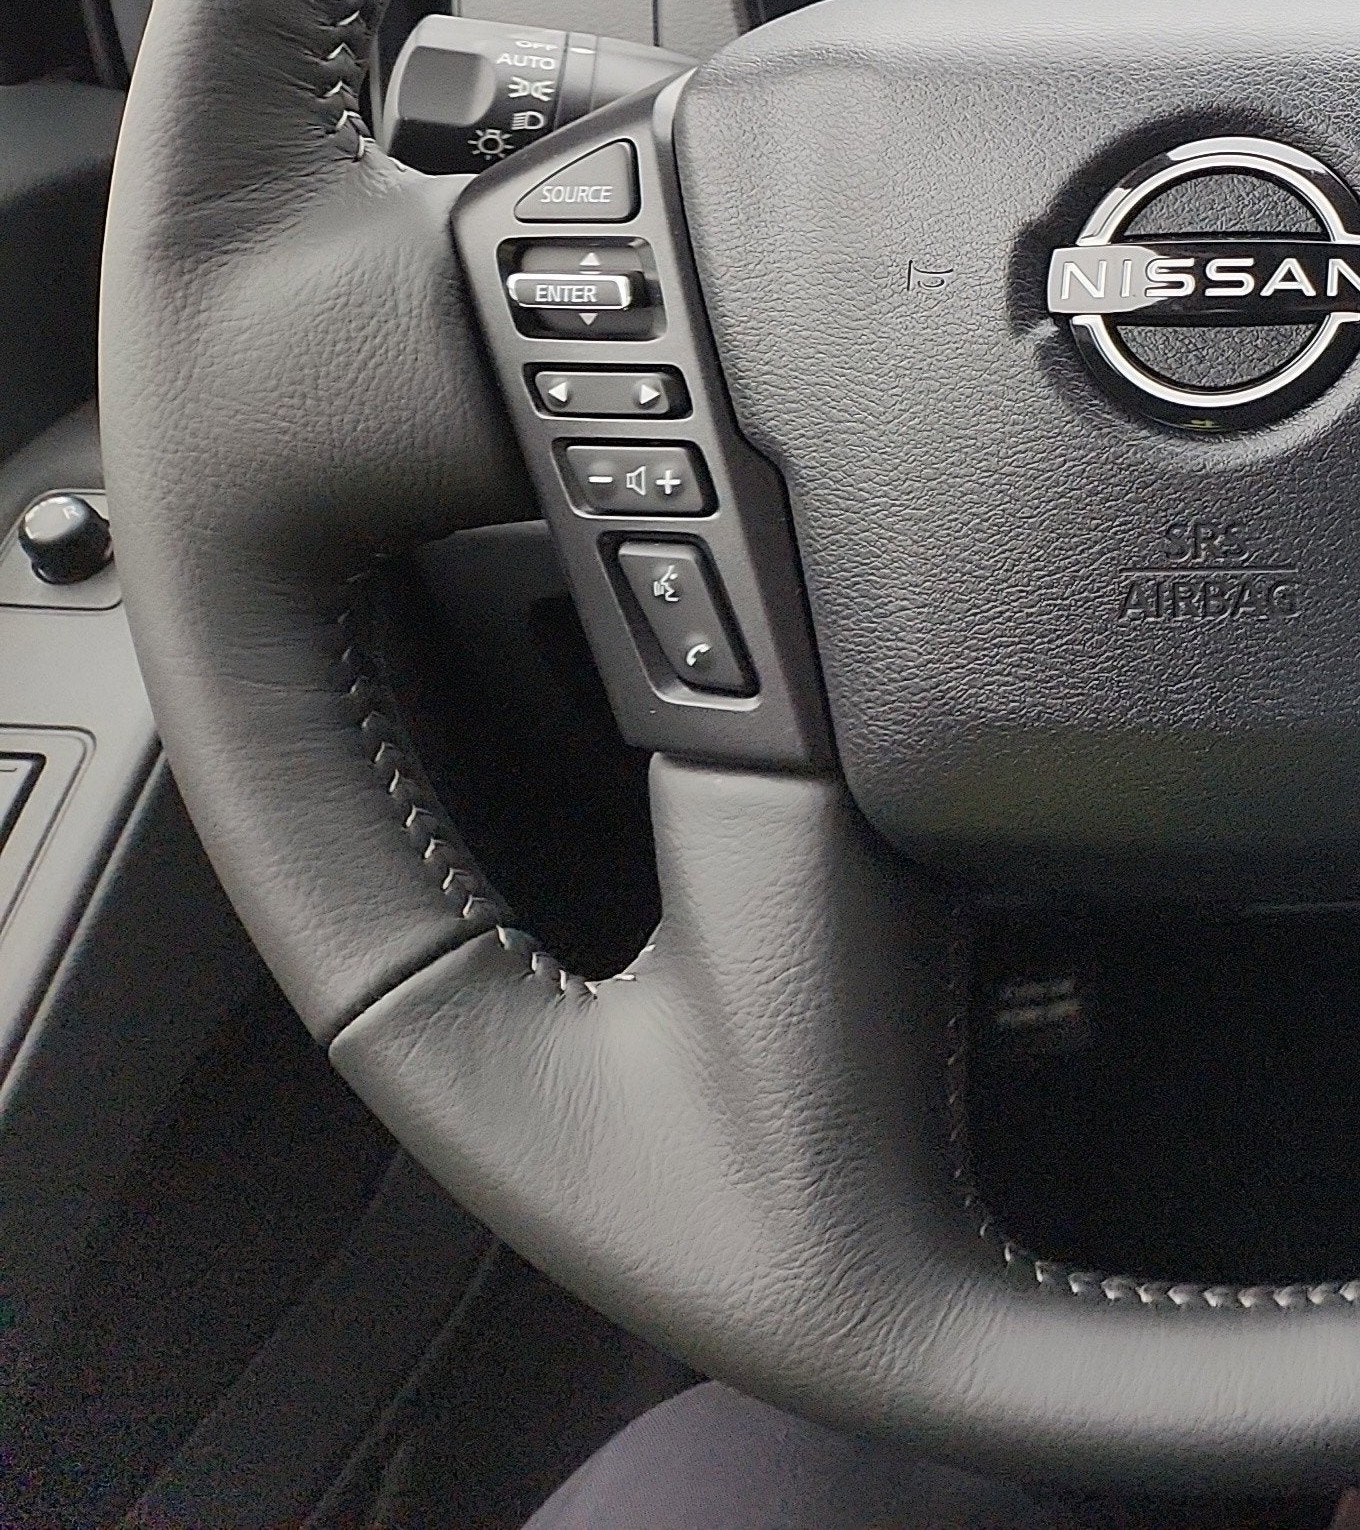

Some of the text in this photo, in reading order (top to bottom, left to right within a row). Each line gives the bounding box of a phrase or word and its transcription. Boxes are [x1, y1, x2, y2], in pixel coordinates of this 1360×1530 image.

[496, 53, 555, 70] AUTO
[541, 185, 612, 204] SOURCE
[535, 282, 597, 304] ENTER
[1161, 522, 1247, 562] SRS
[1116, 579, 1300, 624] AIRBAG
